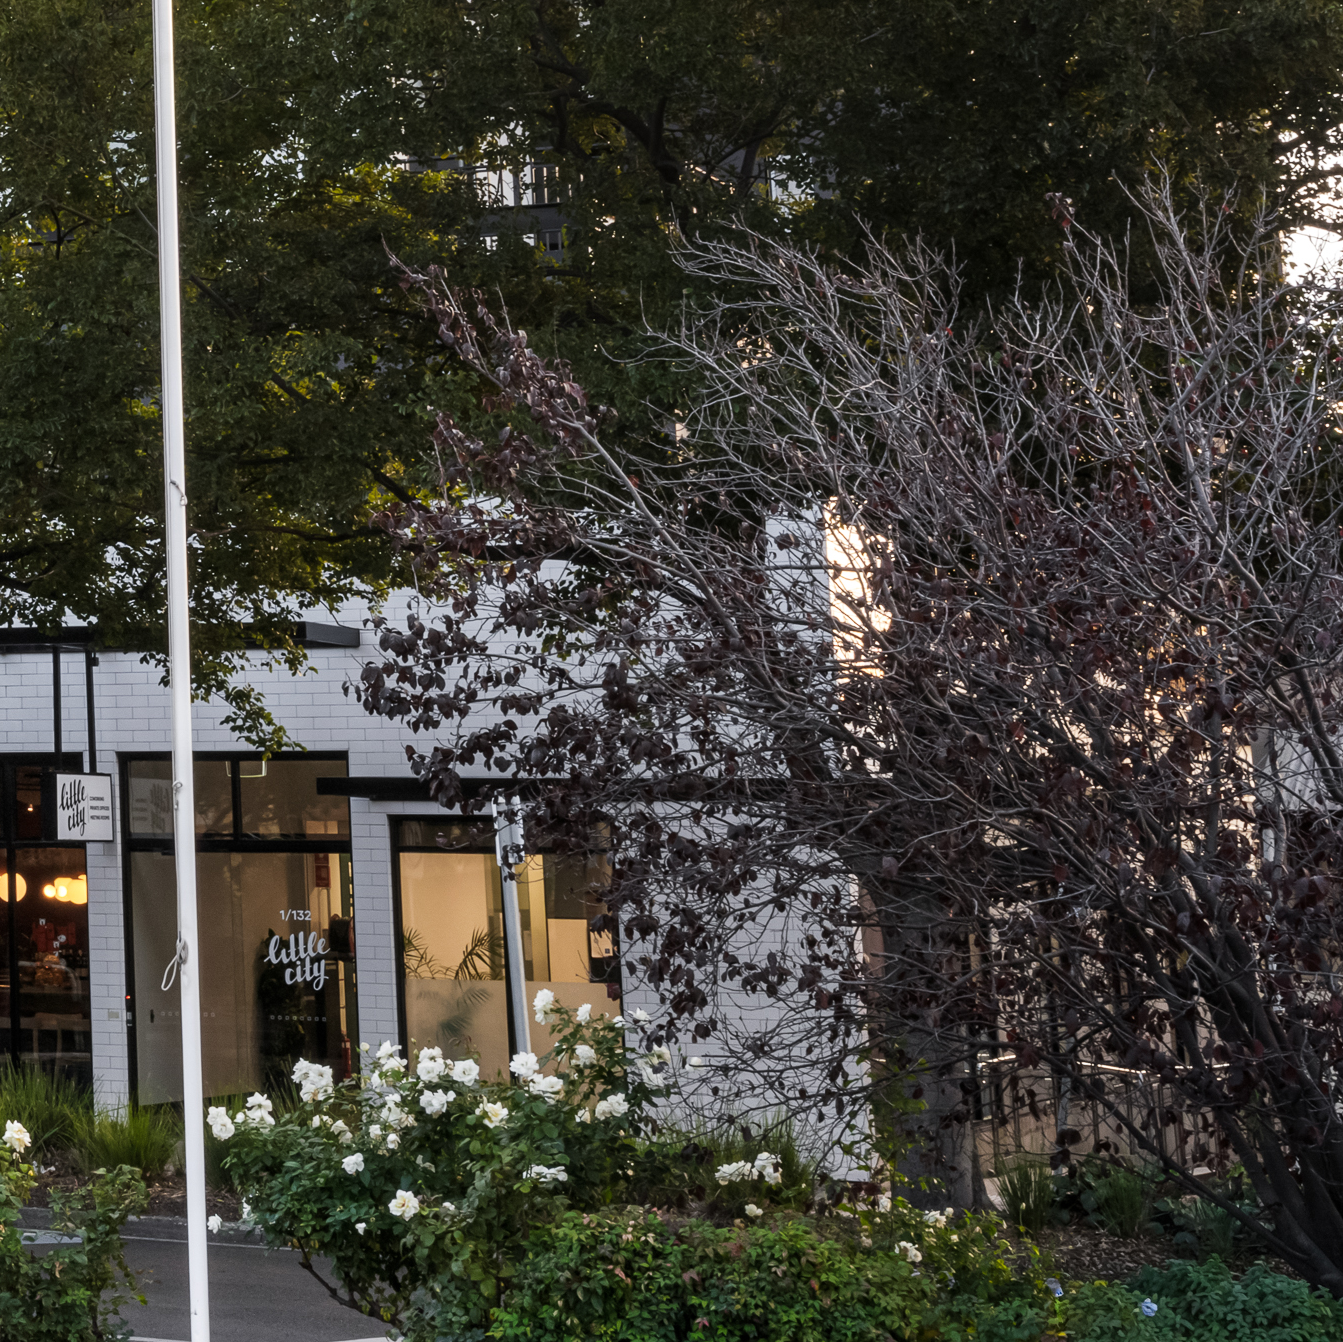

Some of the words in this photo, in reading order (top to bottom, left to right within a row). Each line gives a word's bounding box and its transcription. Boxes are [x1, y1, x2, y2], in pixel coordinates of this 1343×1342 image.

[59, 779, 87, 811] little
[67, 803, 87, 836] city
[279, 908, 312, 922] 1/132
[263, 931, 331, 964] little
[284, 955, 329, 991] city
